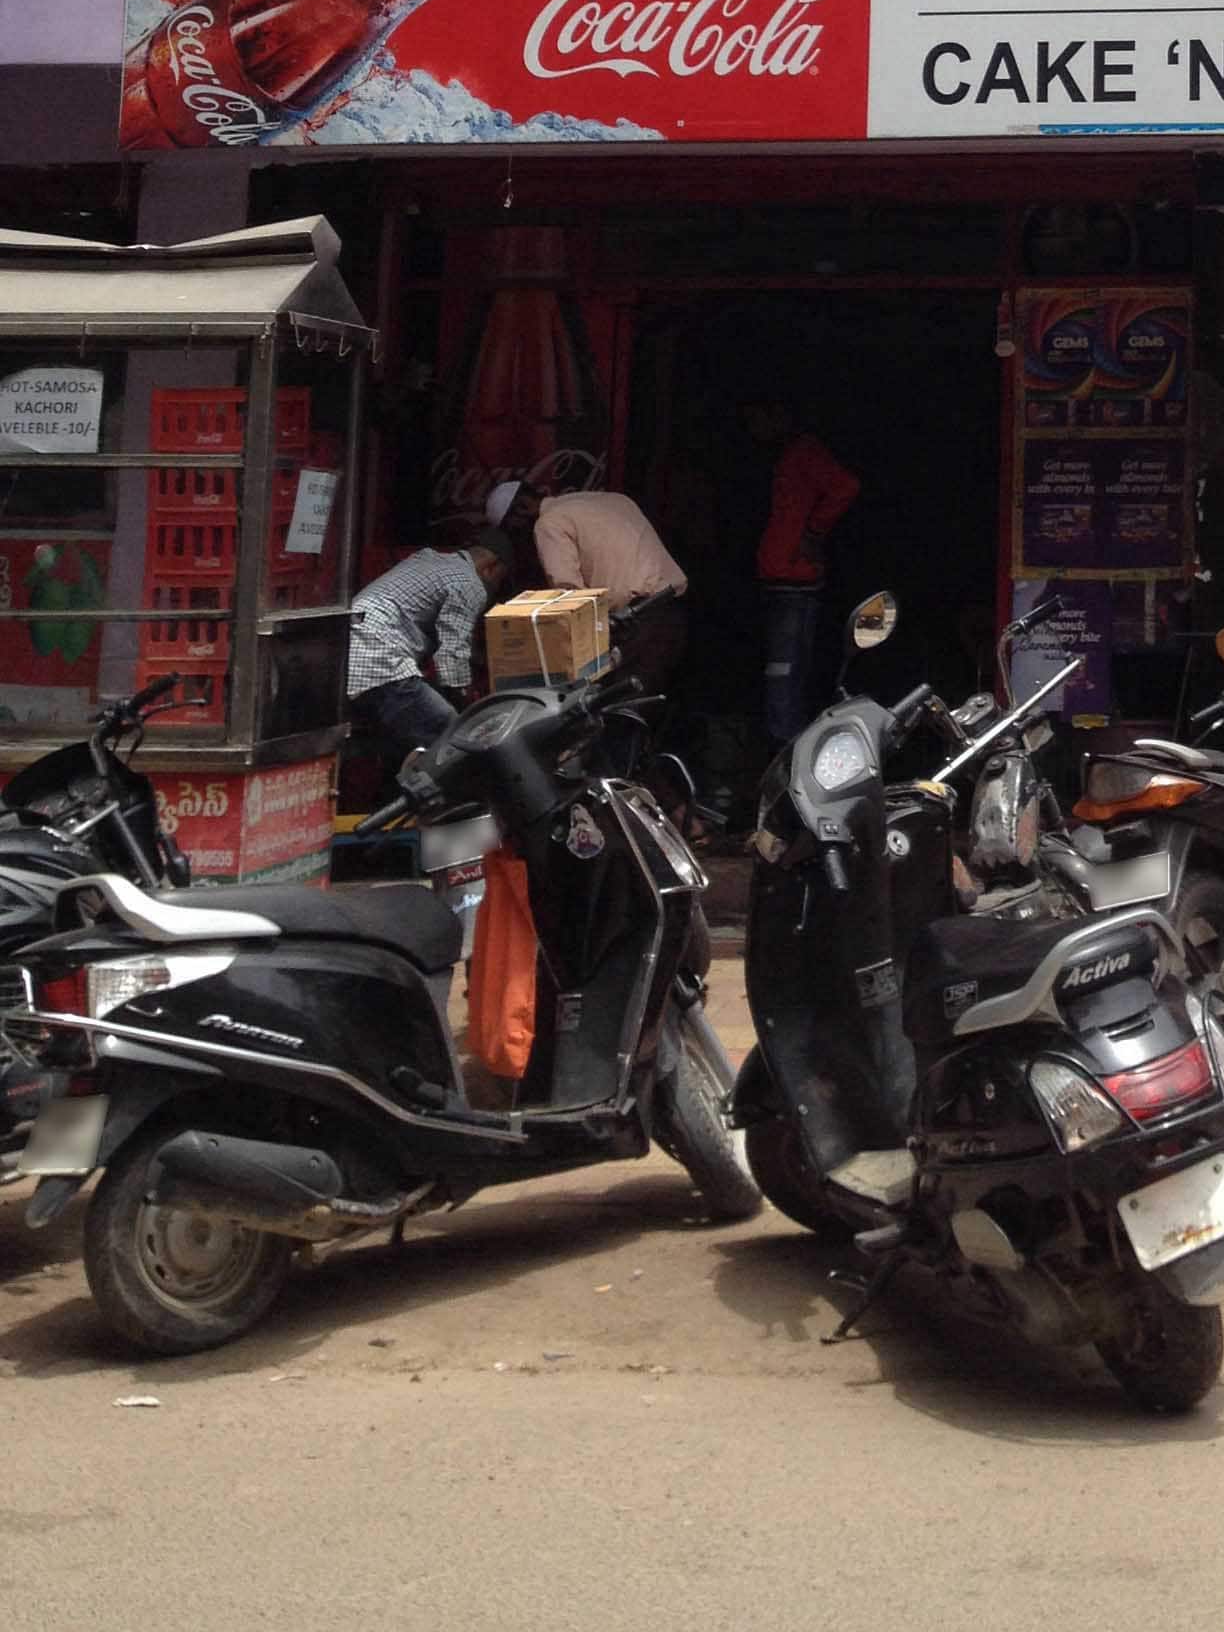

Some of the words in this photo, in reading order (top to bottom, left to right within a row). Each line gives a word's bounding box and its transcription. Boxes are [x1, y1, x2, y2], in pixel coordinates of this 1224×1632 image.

[921, 40, 1137, 106] CAKE
[1052, 336, 1090, 350] GEMS
[1127, 335, 1166, 348] GEMS
[14, 401, 79, 415] KACHORI
[1061, 952, 1132, 990] Activa
